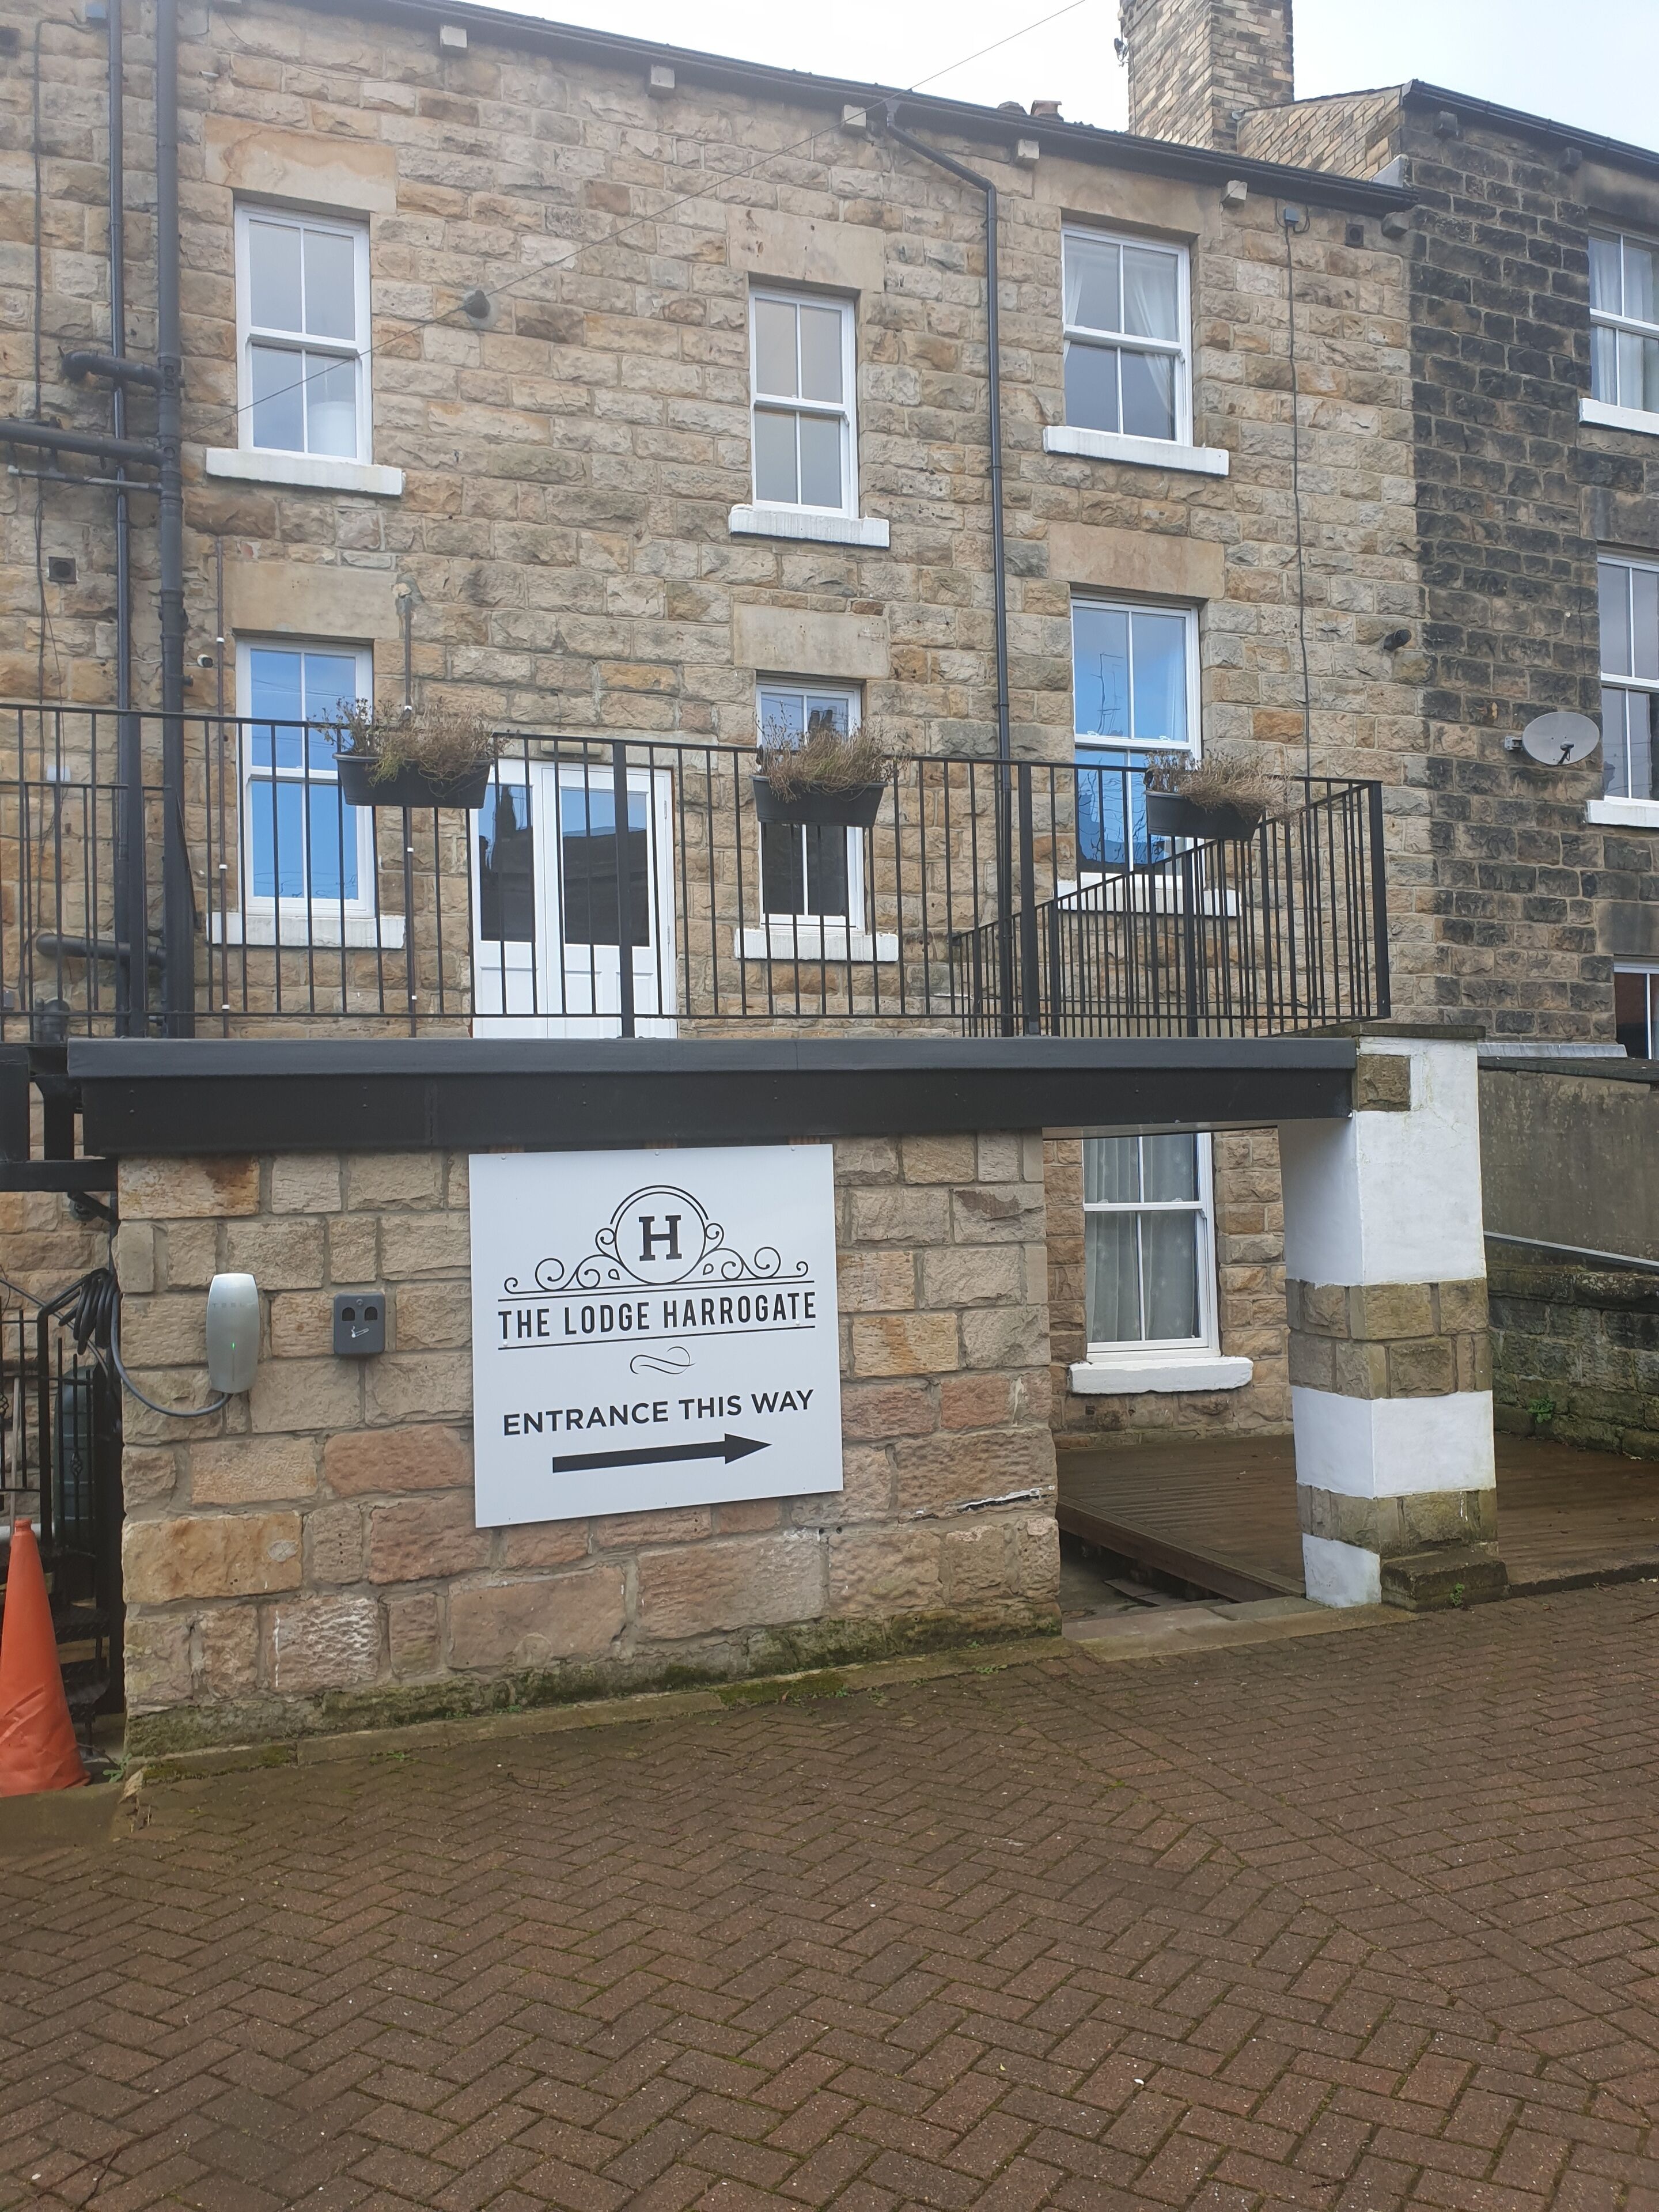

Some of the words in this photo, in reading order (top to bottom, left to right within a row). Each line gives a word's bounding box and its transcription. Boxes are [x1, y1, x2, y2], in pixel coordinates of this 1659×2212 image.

[638, 1214, 682, 1262] H
[498, 1308, 550, 1339] THE
[565, 1302, 650, 1335] LODGE
[664, 1291, 816, 1328] HARROGATE
[503, 1401, 669, 1436] ENTRANCE
[678, 1395, 742, 1420] THIS
[751, 1389, 814, 1414] WAY
